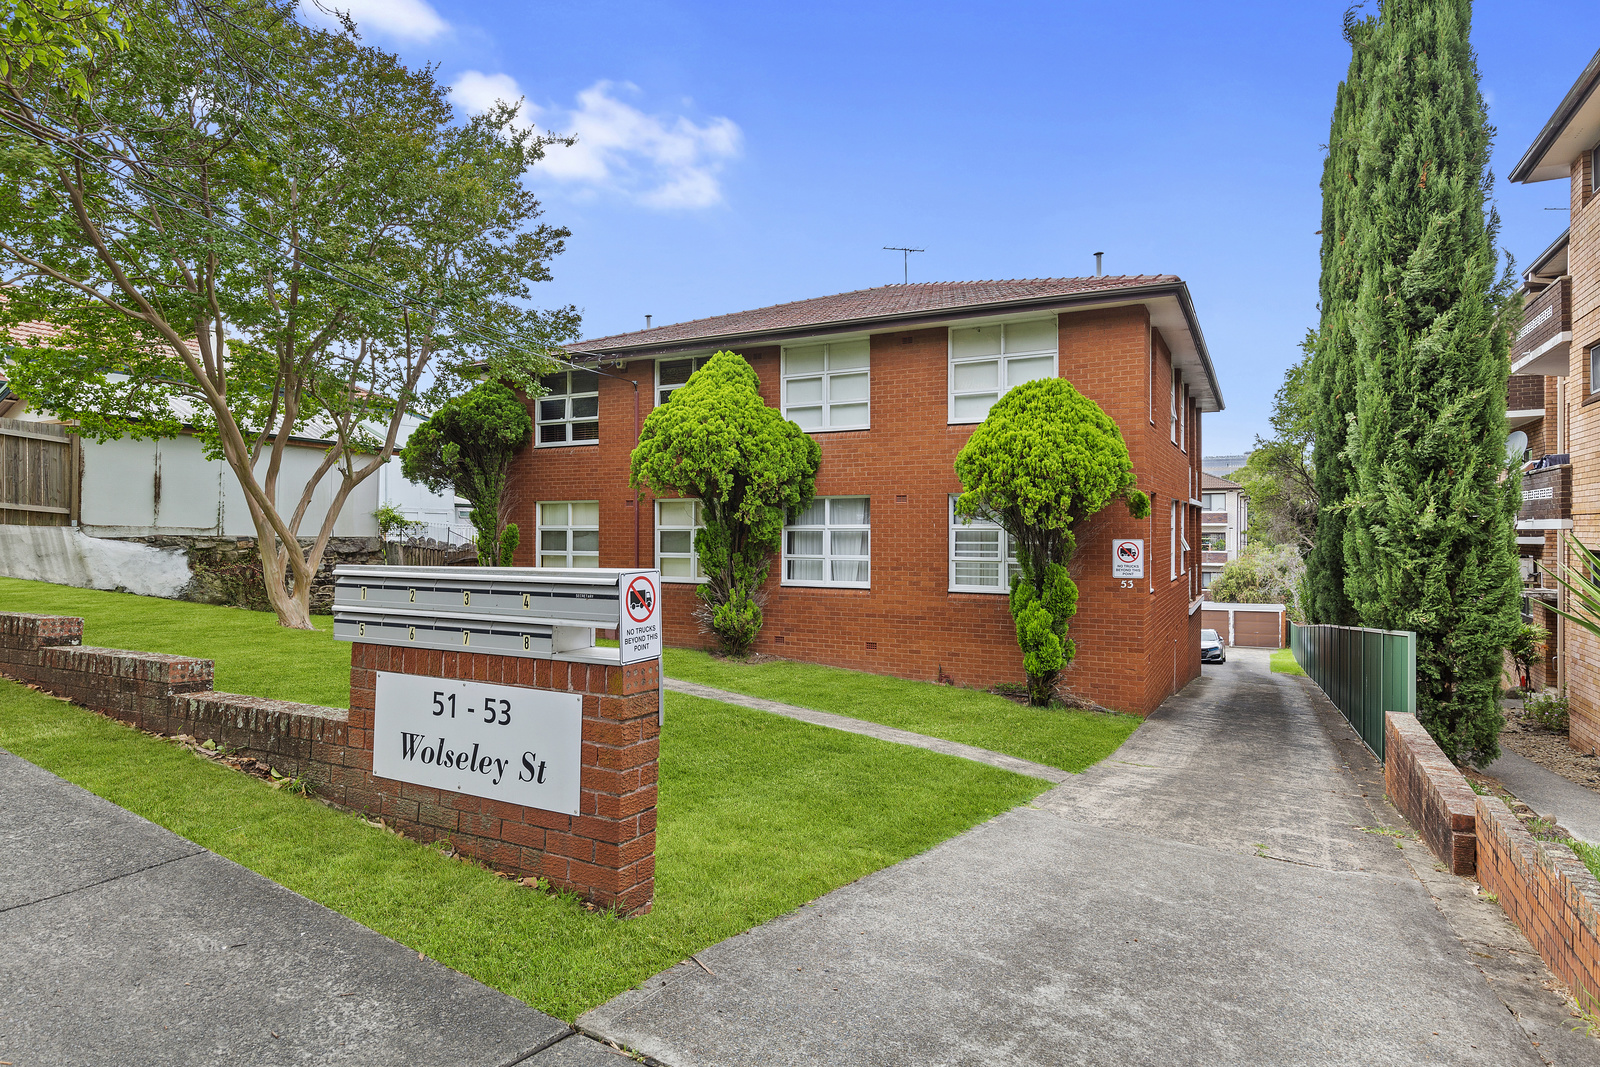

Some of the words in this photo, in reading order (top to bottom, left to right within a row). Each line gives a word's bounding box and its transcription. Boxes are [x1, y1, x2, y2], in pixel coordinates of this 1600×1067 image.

[1120, 580, 1134, 589] 53
[410, 590, 415, 602] 2
[464, 592, 469, 606] 3
[523, 595, 529, 608] 4
[360, 624, 364, 636] 5
[410, 628, 414, 640] 6
[636, 625, 656, 634] TRUCKS
[464, 632, 469, 644] 7
[524, 636, 529, 649] 8
[625, 636, 646, 645] BEYOND
[647, 633, 658, 641] THIS
[634, 643, 650, 652] POINT
[432, 691, 456, 718] 51
[484, 698, 512, 726] 53
[400, 731, 509, 785] Wolseley
[518, 751, 547, 784] St
